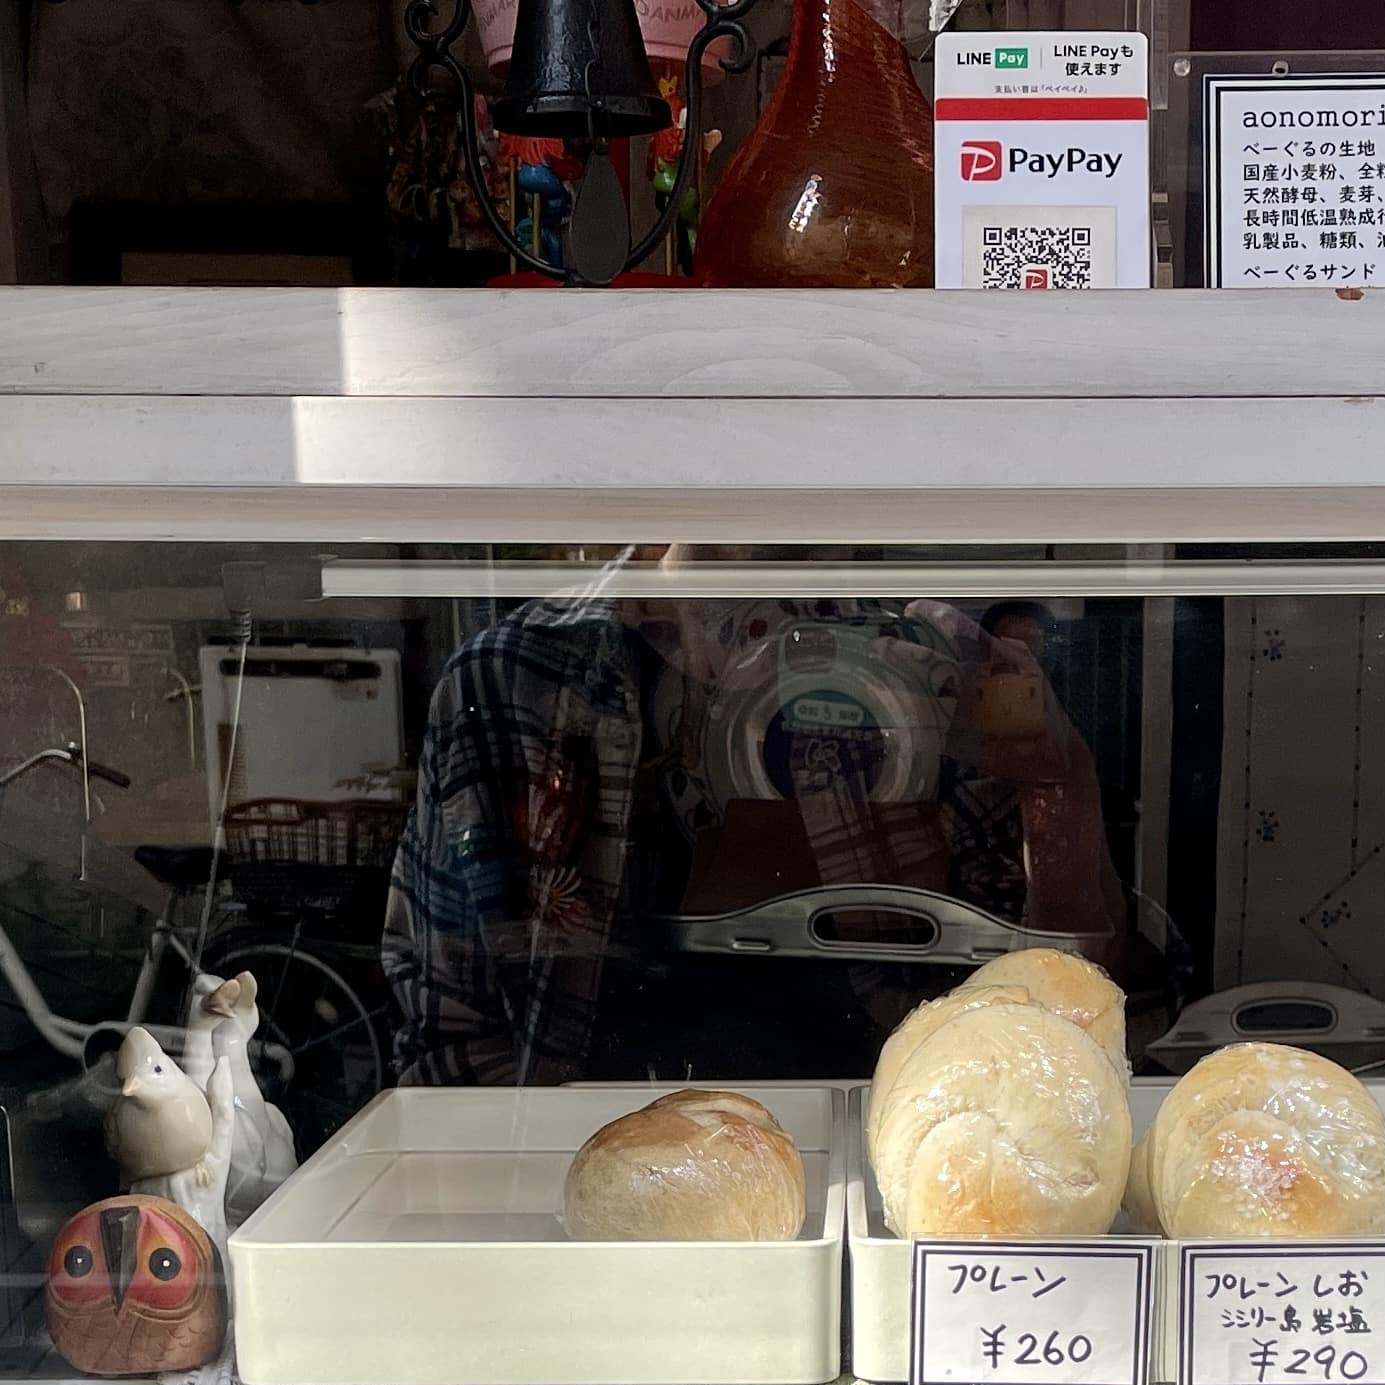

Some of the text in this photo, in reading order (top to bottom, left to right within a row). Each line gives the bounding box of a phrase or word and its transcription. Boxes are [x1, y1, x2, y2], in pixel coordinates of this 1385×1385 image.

[957, 52, 1025, 65] LINE Pay
[1054, 45, 1087, 57] LINE
[1066, 62, 1121, 76] 使えます
[1243, 139, 1376, 157] べーぐるの生地
[1009, 148, 1123, 178] PayPay
[1244, 264, 1376, 281] べーぐるサンド
[948, 1264, 1067, 1298] プレーン
[980, 1324, 1092, 1368] ¥260
[1249, 1338, 1368, 1382] ¥290
